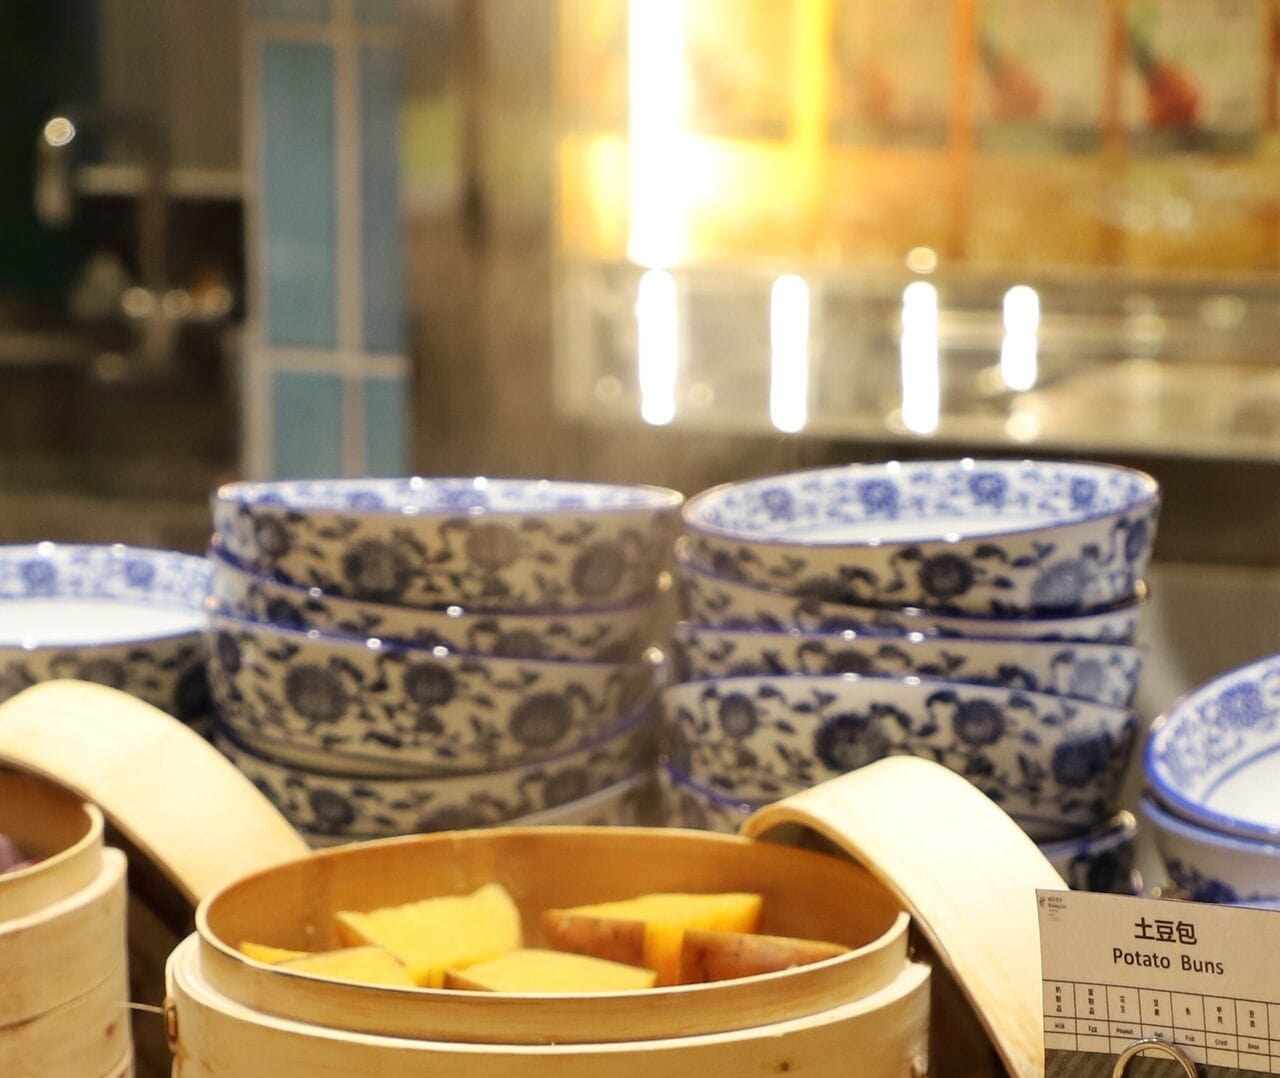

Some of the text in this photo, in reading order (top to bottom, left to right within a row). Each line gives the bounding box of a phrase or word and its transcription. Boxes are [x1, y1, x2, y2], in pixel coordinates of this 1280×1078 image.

[1134, 916, 1198, 946] 土豆包
[1113, 947, 1225, 976] Potato Buns
